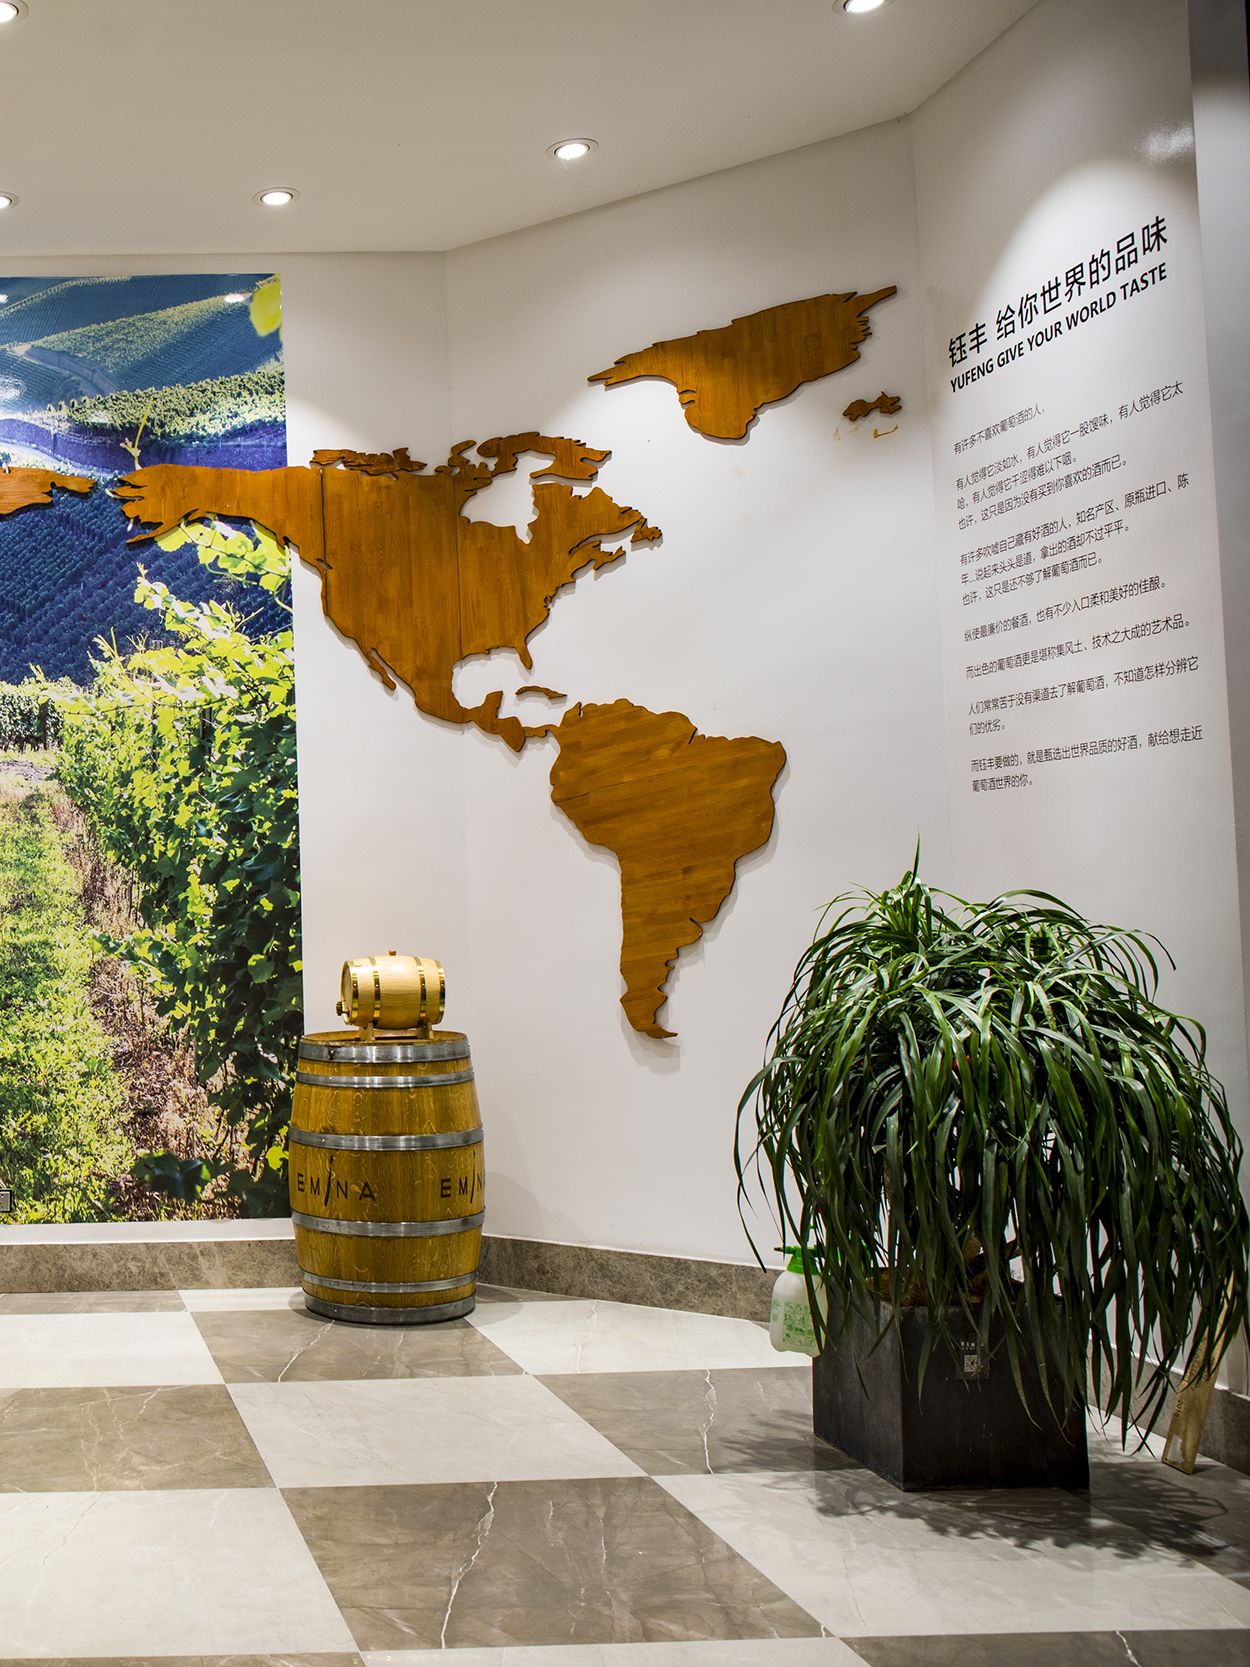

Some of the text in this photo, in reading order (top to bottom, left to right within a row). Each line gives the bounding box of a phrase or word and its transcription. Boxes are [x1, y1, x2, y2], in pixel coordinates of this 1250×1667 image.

[950, 262, 1168, 394] YUFENG GIVE YOUR WORLD TASTE
